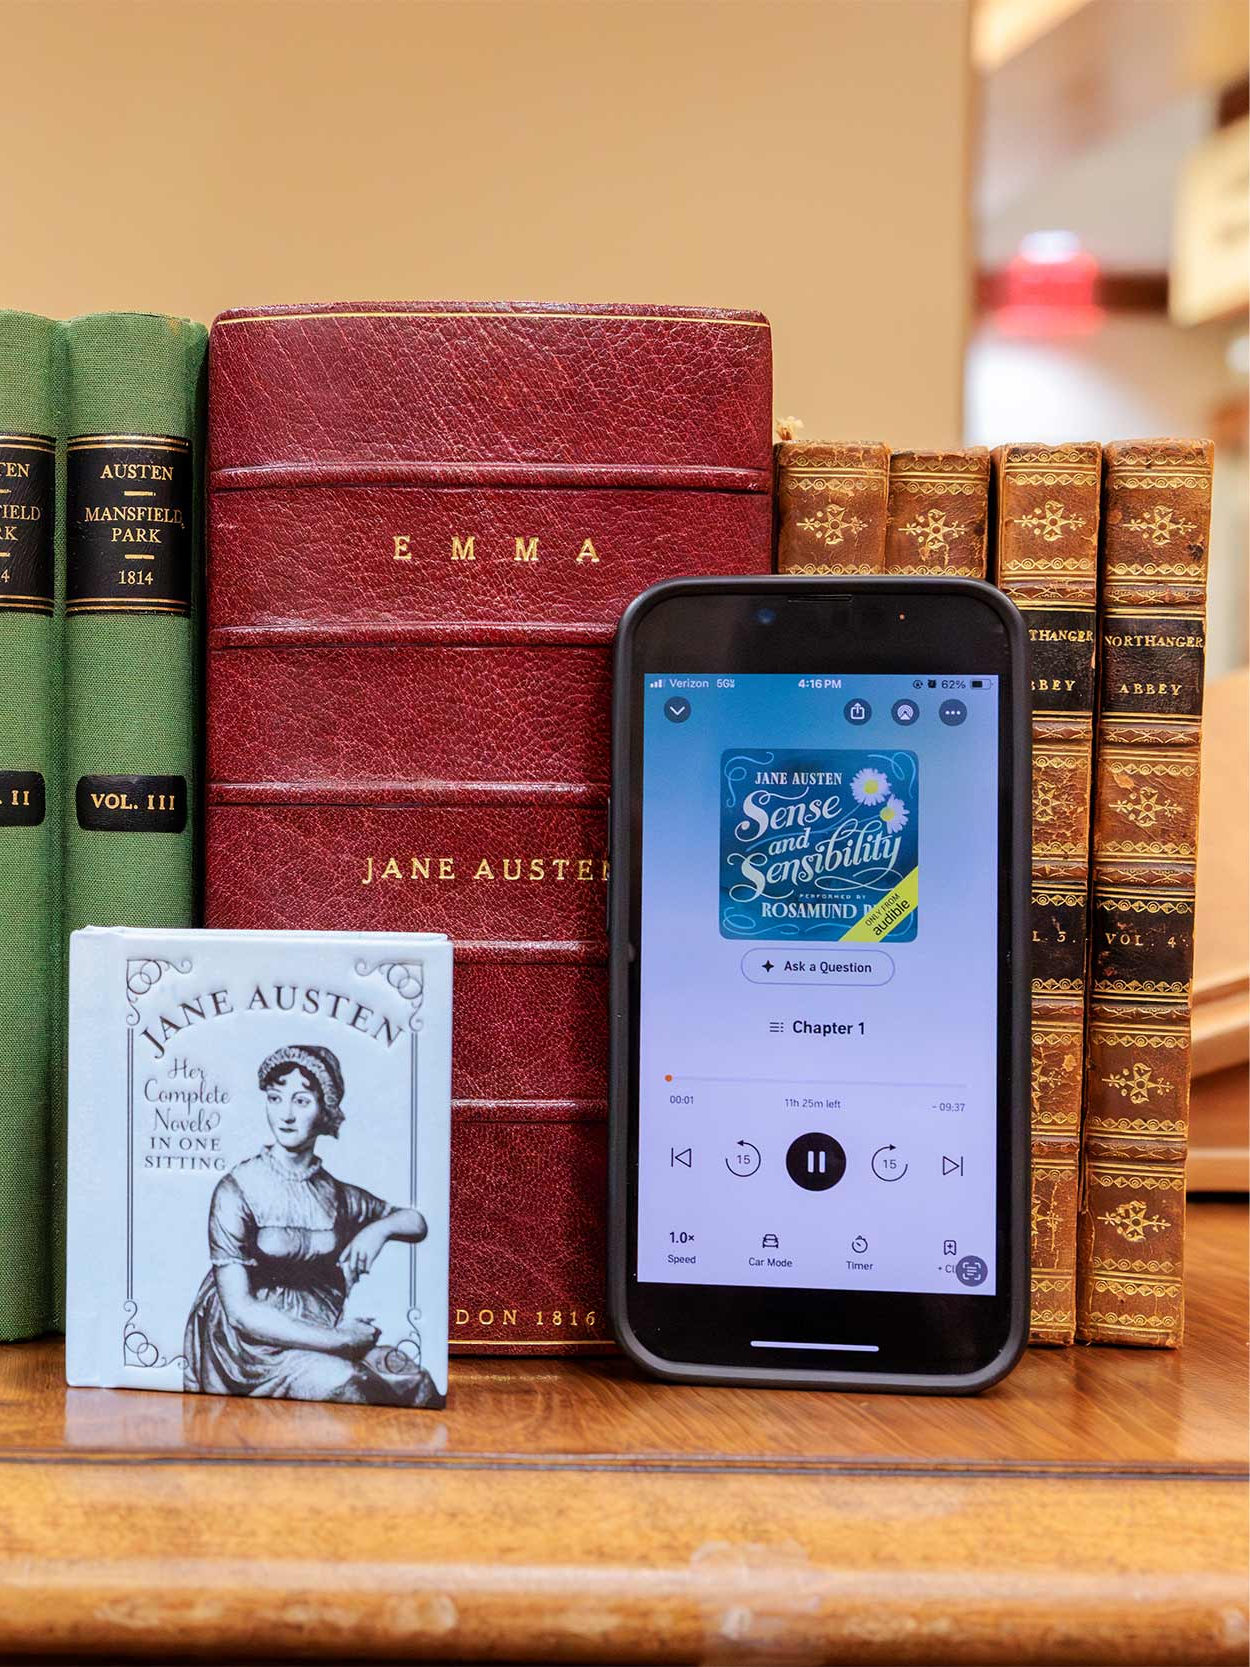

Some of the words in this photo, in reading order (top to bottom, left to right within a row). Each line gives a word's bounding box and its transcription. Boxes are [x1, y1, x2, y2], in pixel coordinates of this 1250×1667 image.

[100, 464, 173, 481] AUSTEN
[84, 506, 183, 525] MANSFIELD
[111, 527, 162, 543] PARK
[392, 535, 600, 562] EMMA
[118, 570, 154, 586] 1814
[1028, 629, 1094, 642] THANGER
[1104, 635, 1204, 649] NORTHANGER
[670, 679, 709, 688] Verizon
[798, 679, 823, 689] 4:16
[824, 679, 842, 689] PM
[941, 679, 966, 690] 62%
[1031, 679, 1076, 692] BEY
[1119, 683, 1182, 696] ABBEY
[754, 771, 787, 786] JANE
[792, 772, 843, 786] AUSTEN
[11, 790, 30, 806] II
[91, 793, 139, 810] VOL.
[148, 795, 175, 811] III
[734, 787, 843, 842] Sense
[768, 828, 810, 856] and
[726, 818, 905, 903] Sensibility
[362, 857, 455, 884] JANE
[761, 902, 857, 919] ROSAMUND
[865, 909, 884, 926] ONLY
[882, 893, 901, 912] FROM
[872, 898, 911, 936] audible
[1105, 933, 1155, 947] VOL.
[783, 961, 805, 972] Ask
[809, 963, 816, 972] a
[819, 961, 872, 974] Question
[139, 989, 234, 1059] JANE
[249, 985, 406, 1049] AUSTEN
[792, 1020, 854, 1037] Chapter
[858, 1021, 866, 1035] 1
[167, 1058, 207, 1080] Her
[144, 1078, 230, 1115] Complete
[669, 1095, 694, 1105] 00:01
[784, 1098, 800, 1108] 11h
[802, 1099, 823, 1109] 25m
[825, 1098, 841, 1109] left
[939, 1103, 965, 1113] 09:37
[153, 1108, 221, 1133] Novels
[150, 1137, 171, 1150] IN
[179, 1137, 222, 1151] ONE
[144, 1155, 226, 1171] SITTING
[736, 1154, 751, 1165] 15
[882, 1159, 897, 1170] 15
[667, 1254, 696, 1265] Speed
[748, 1257, 764, 1268] Car
[766, 1257, 793, 1269] Mode
[845, 1261, 873, 1272] Timer
[456, 1309, 517, 1325] DON
[536, 1311, 596, 1326] 1816
